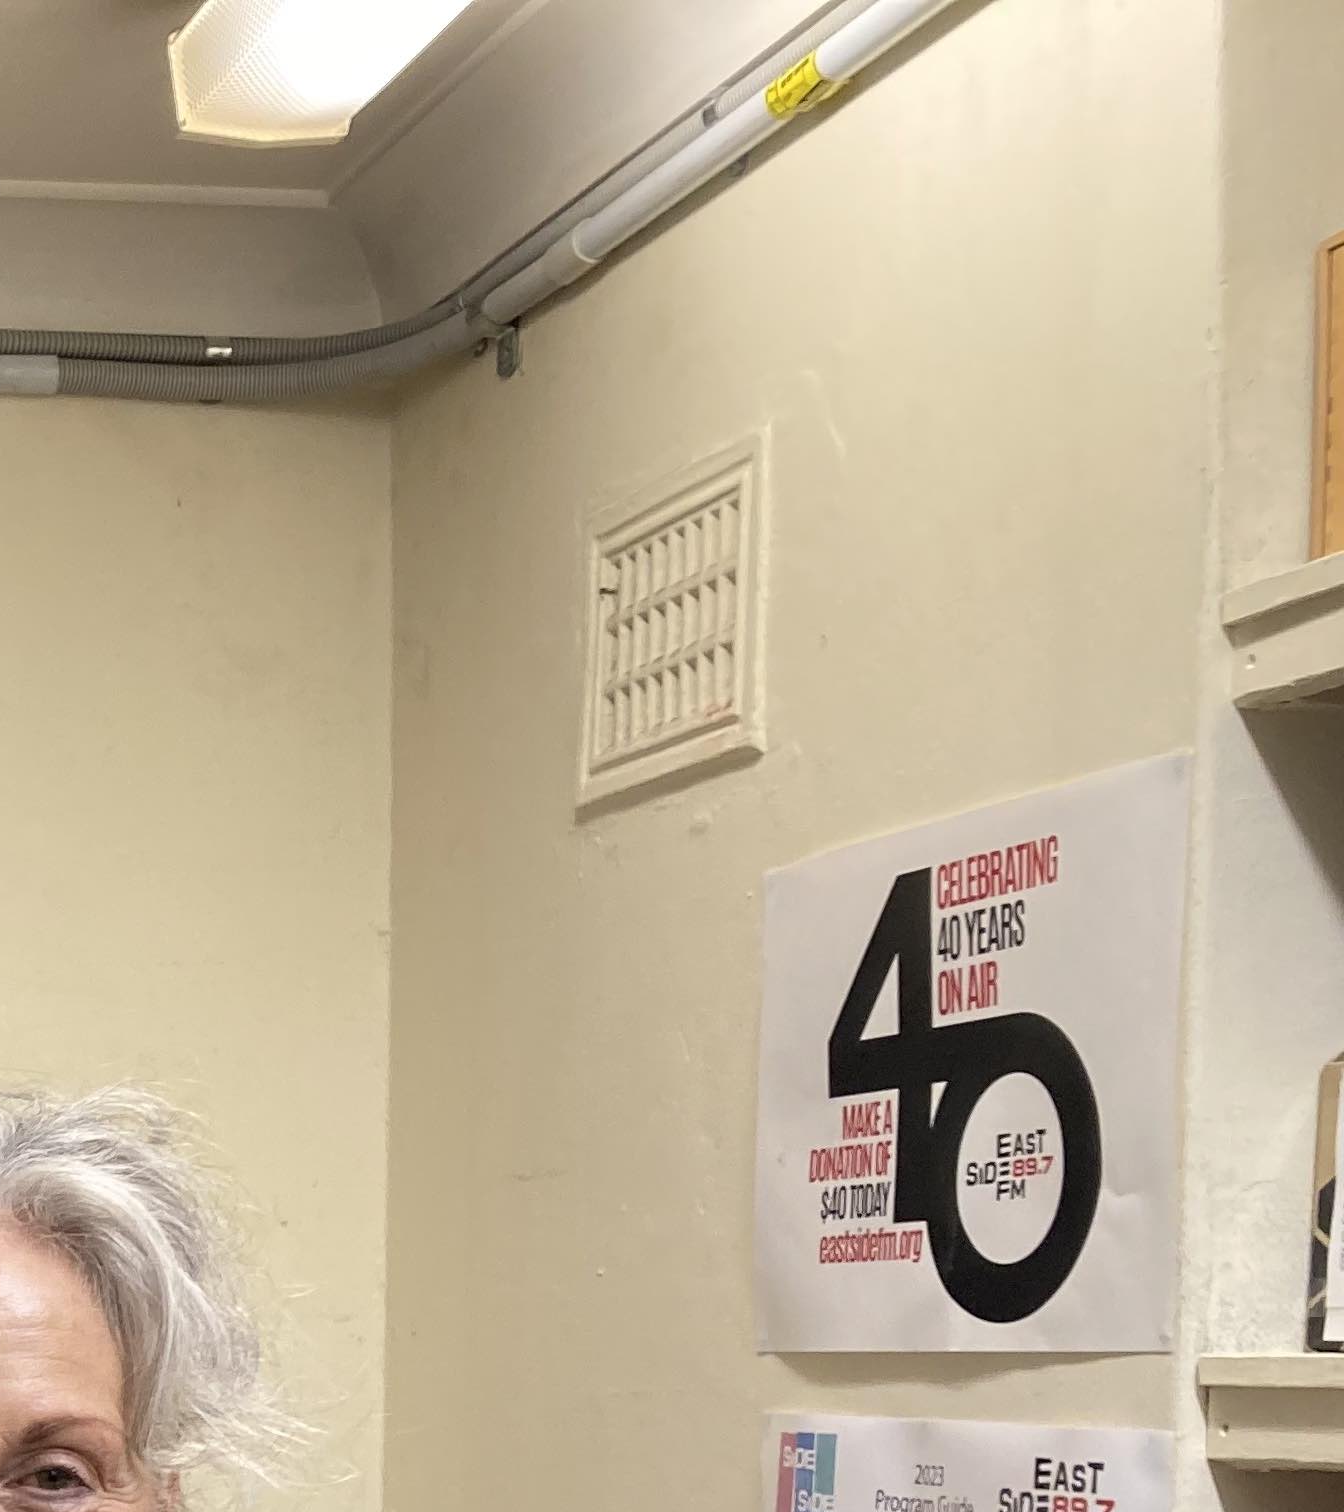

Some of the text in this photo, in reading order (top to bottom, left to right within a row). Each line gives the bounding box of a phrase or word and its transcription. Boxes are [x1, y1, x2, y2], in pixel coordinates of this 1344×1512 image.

[937, 835, 1059, 910] CELEBRATING
[937, 900, 1026, 962] 40 YEARS
[938, 961, 999, 1016] ON AIR
[842, 1100, 892, 1140] MAKE A
[808, 1141, 892, 1183] DONATION OF
[997, 1128, 1046, 1158] EAST
[820, 1182, 892, 1224] $40 TODAY
[996, 1179, 1026, 1201] FM
[819, 1228, 923, 1264] eastsidefm.org
[914, 1464, 945, 1487] 2023
[1034, 1458, 1105, 1494] EAST
